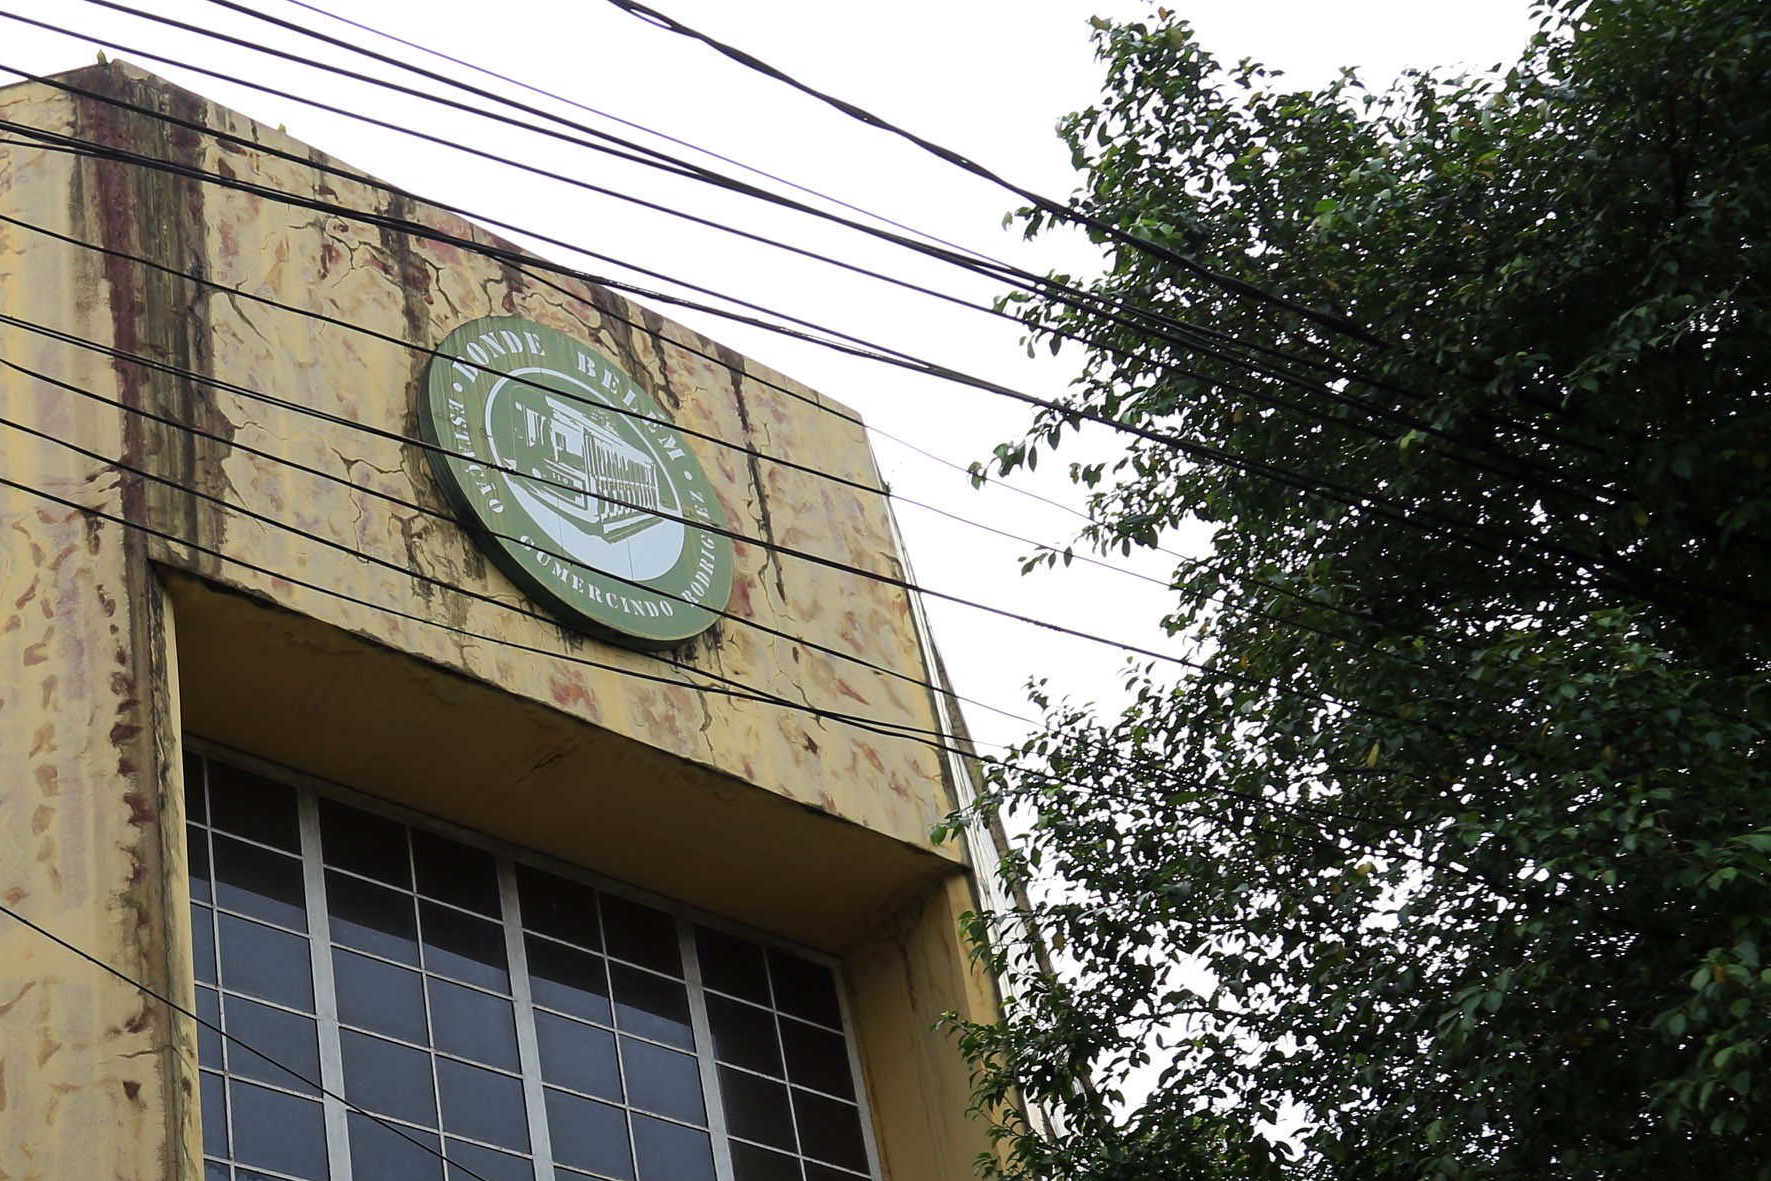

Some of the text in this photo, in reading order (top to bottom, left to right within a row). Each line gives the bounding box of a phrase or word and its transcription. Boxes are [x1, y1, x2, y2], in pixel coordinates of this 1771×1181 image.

[452, 330, 686, 462] BONDE BELÉM
[448, 398, 504, 514] ESTAÇÃO
[519, 534, 674, 617] GUMERCINDO
